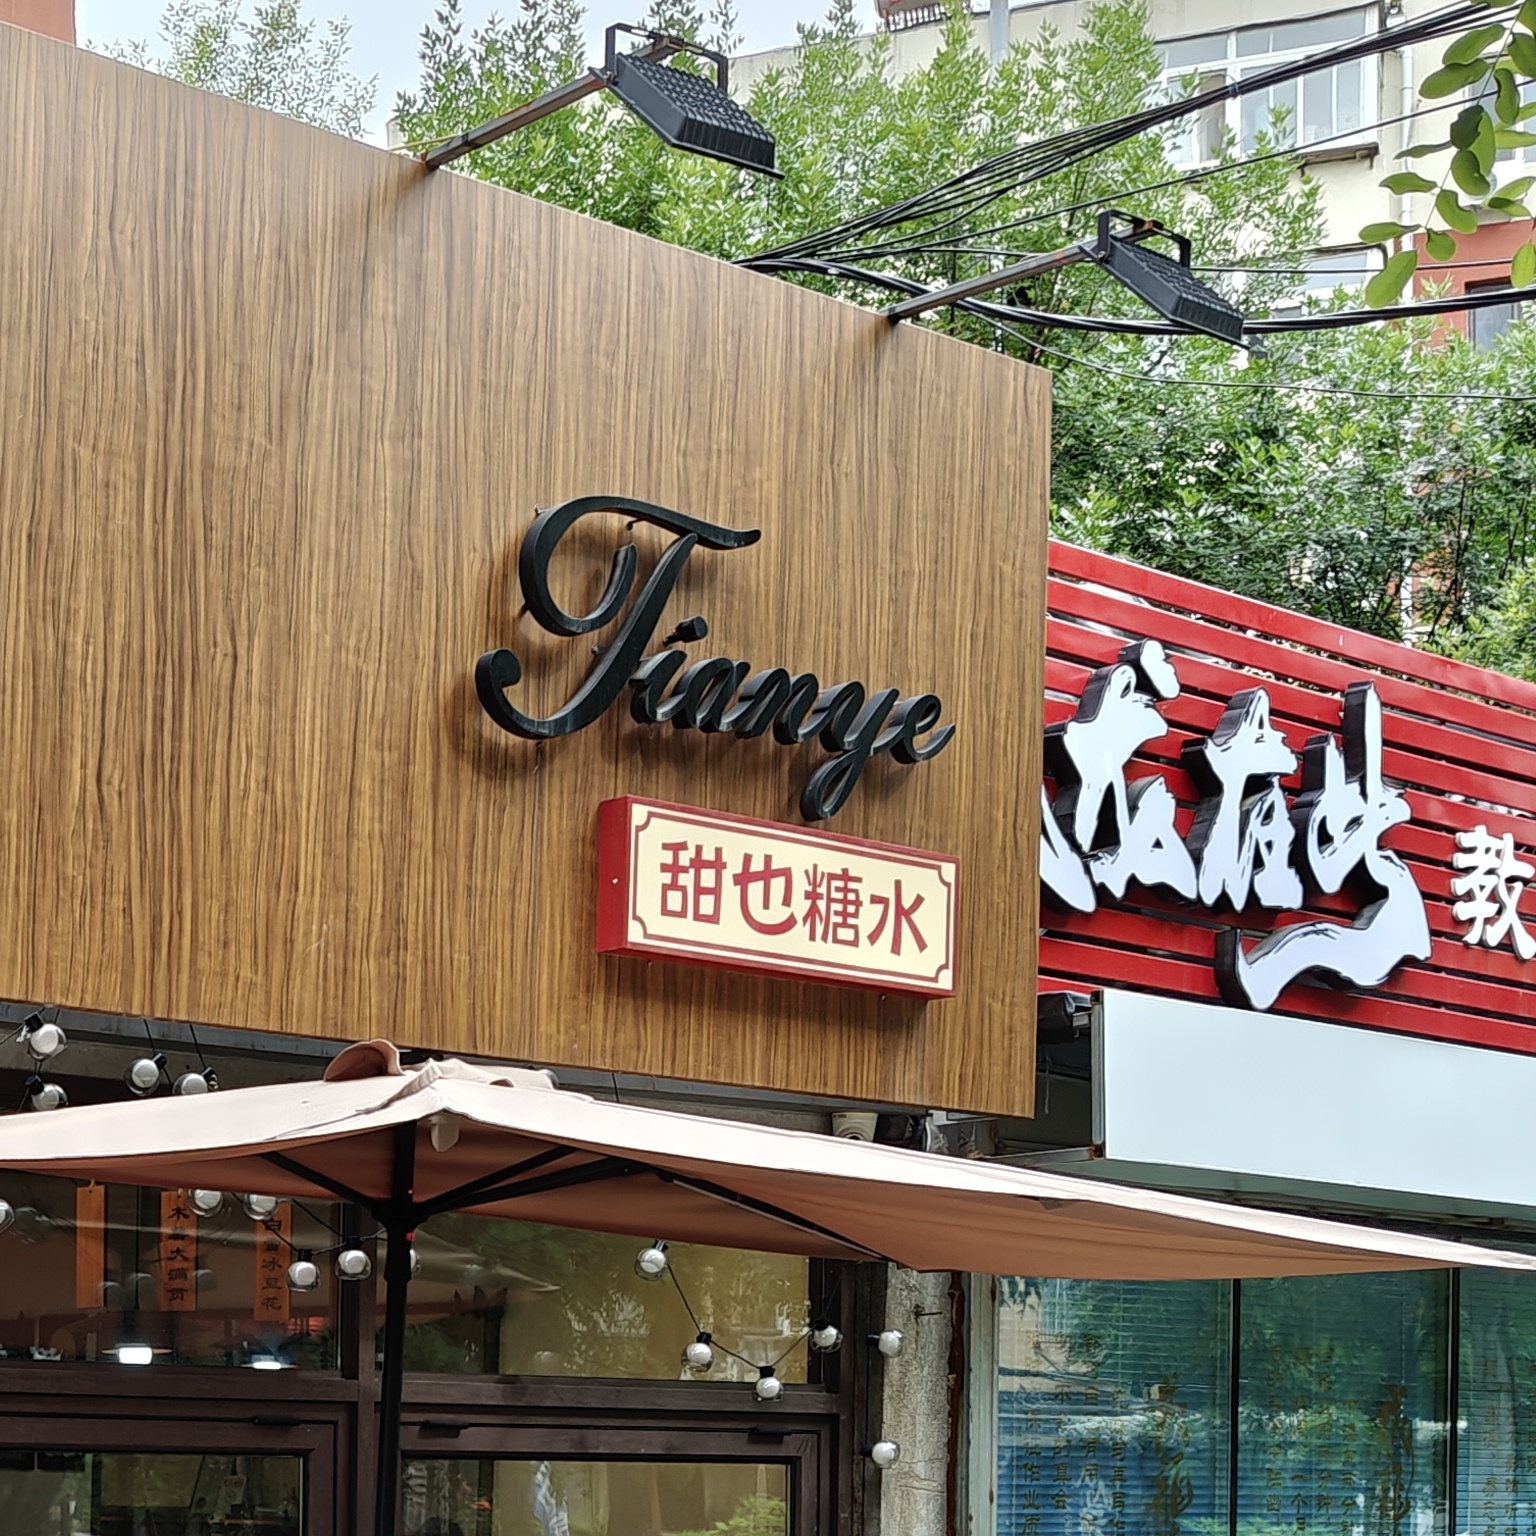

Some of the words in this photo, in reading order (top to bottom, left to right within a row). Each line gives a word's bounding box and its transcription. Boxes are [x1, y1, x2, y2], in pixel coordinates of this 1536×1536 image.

[475, 495, 955, 821] Tianye
[658, 839, 930, 959] 甜也糖水
